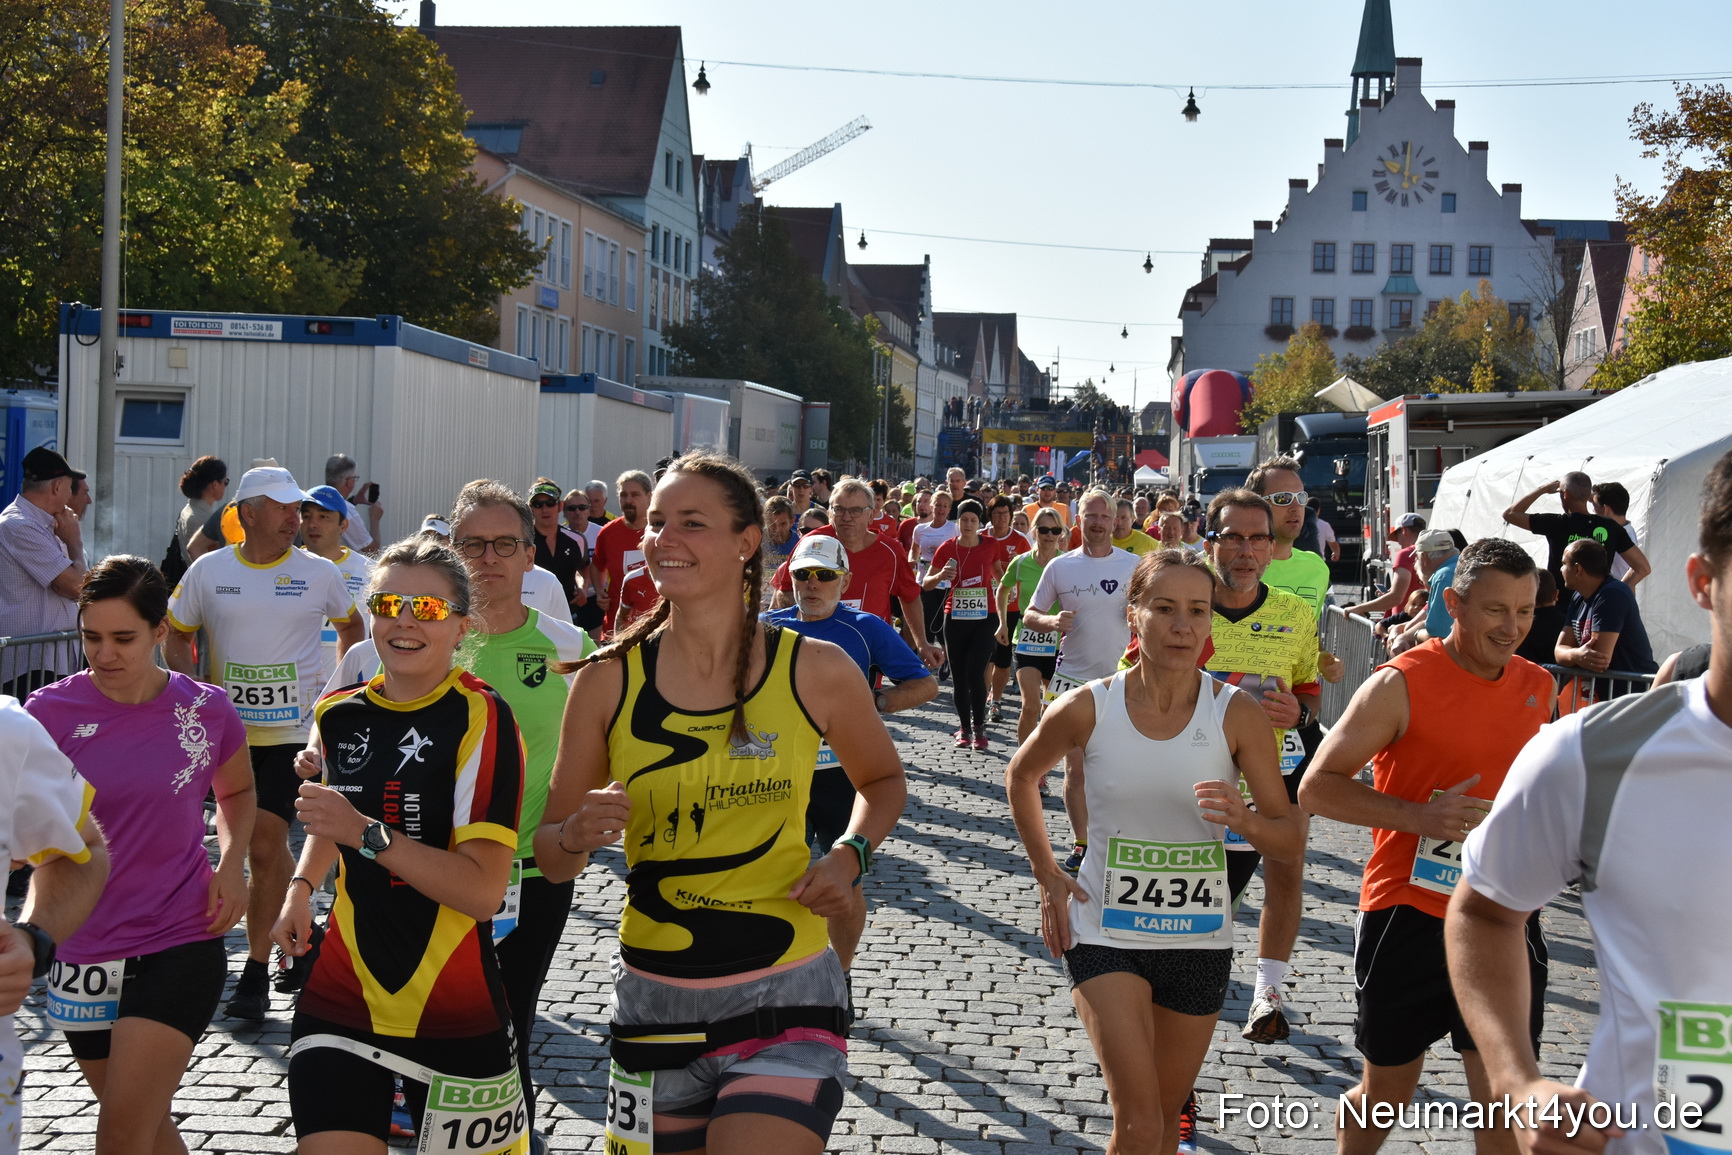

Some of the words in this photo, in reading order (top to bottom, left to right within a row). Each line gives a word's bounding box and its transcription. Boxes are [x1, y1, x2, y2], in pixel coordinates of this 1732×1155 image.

[1018, 433, 1056, 443] START
[276, 576, 291, 585] 20
[1105, 582, 1115, 591] IT
[955, 589, 984, 597] BOCK
[956, 599, 984, 609] 2564
[1022, 631, 1053, 644] 2484
[229, 665, 291, 681] BOCK
[524, 664, 531, 674] F
[533, 672, 541, 683] C
[232, 685, 288, 706] 2631
[729, 747, 776, 760] beluga
[708, 778, 792, 800] Triathlon
[383, 781, 401, 824] ROTH
[709, 790, 792, 812] HILPOLTSTEIN
[404, 794, 422, 840] THLON
[1116, 842, 1218, 868] BOCK
[1436, 868, 1460, 884] JÜ
[1117, 876, 1212, 908] 2434
[1134, 916, 1192, 931] KARIN
[49, 960, 108, 996] 020
[442, 1098, 524, 1150] 1096
